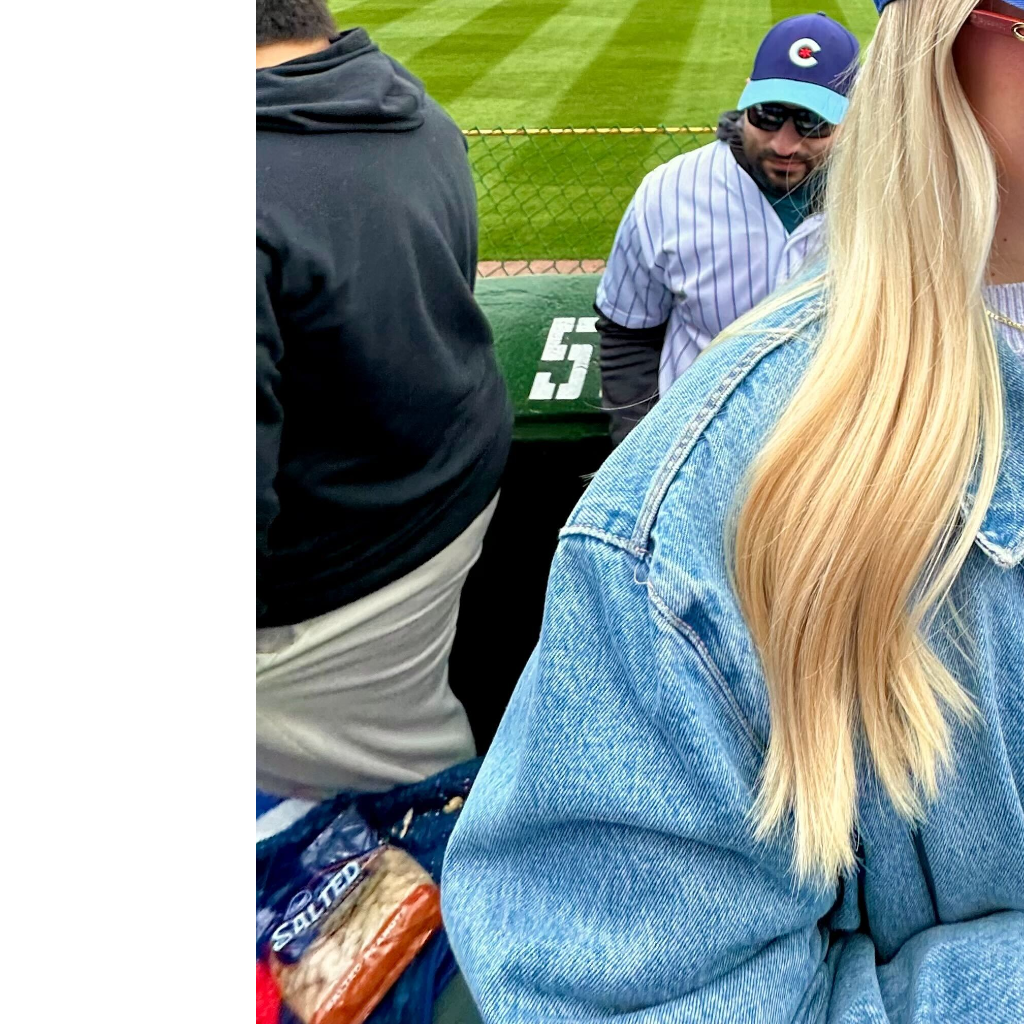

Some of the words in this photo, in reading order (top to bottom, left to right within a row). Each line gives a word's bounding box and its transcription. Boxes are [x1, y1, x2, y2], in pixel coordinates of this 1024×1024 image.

[789, 37, 822, 68] C
[528, 317, 602, 400] 5
[272, 861, 361, 952] SALTED
